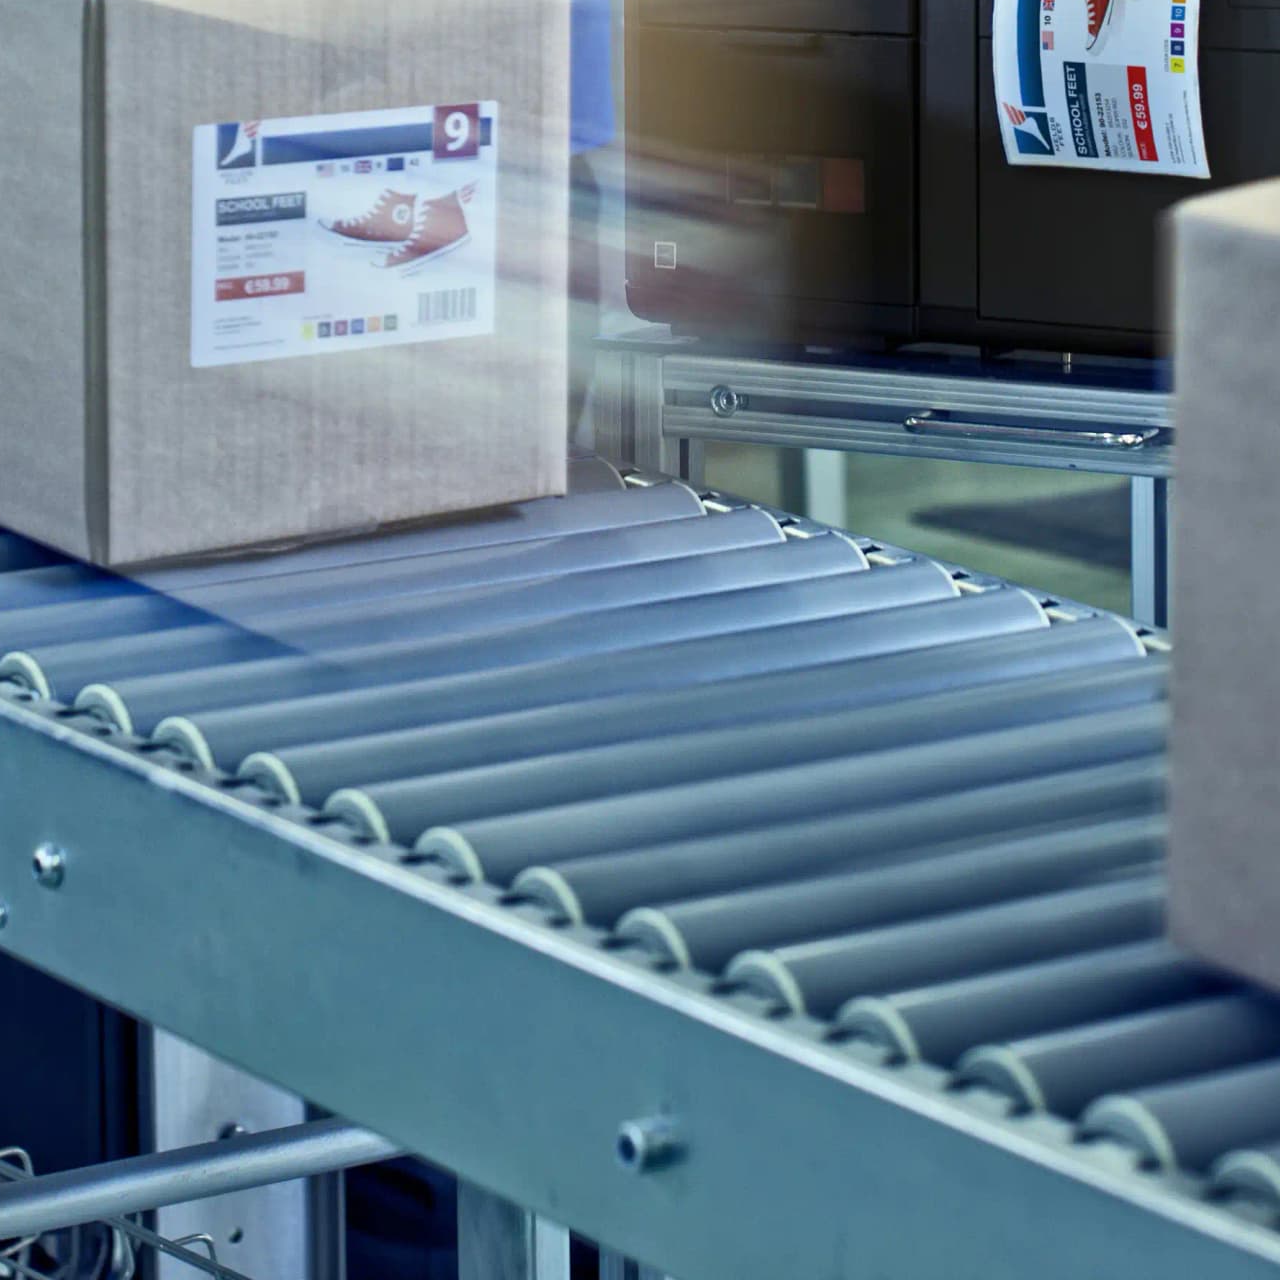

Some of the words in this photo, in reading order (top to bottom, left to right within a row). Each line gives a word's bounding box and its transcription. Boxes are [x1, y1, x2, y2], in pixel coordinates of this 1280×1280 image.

[1065, 64, 1078, 98] FEET
[1132, 83, 1148, 130] €59.99
[443, 111, 470, 151] 9
[1071, 100, 1088, 155] SCHOOL
[272, 194, 304, 209] FEET
